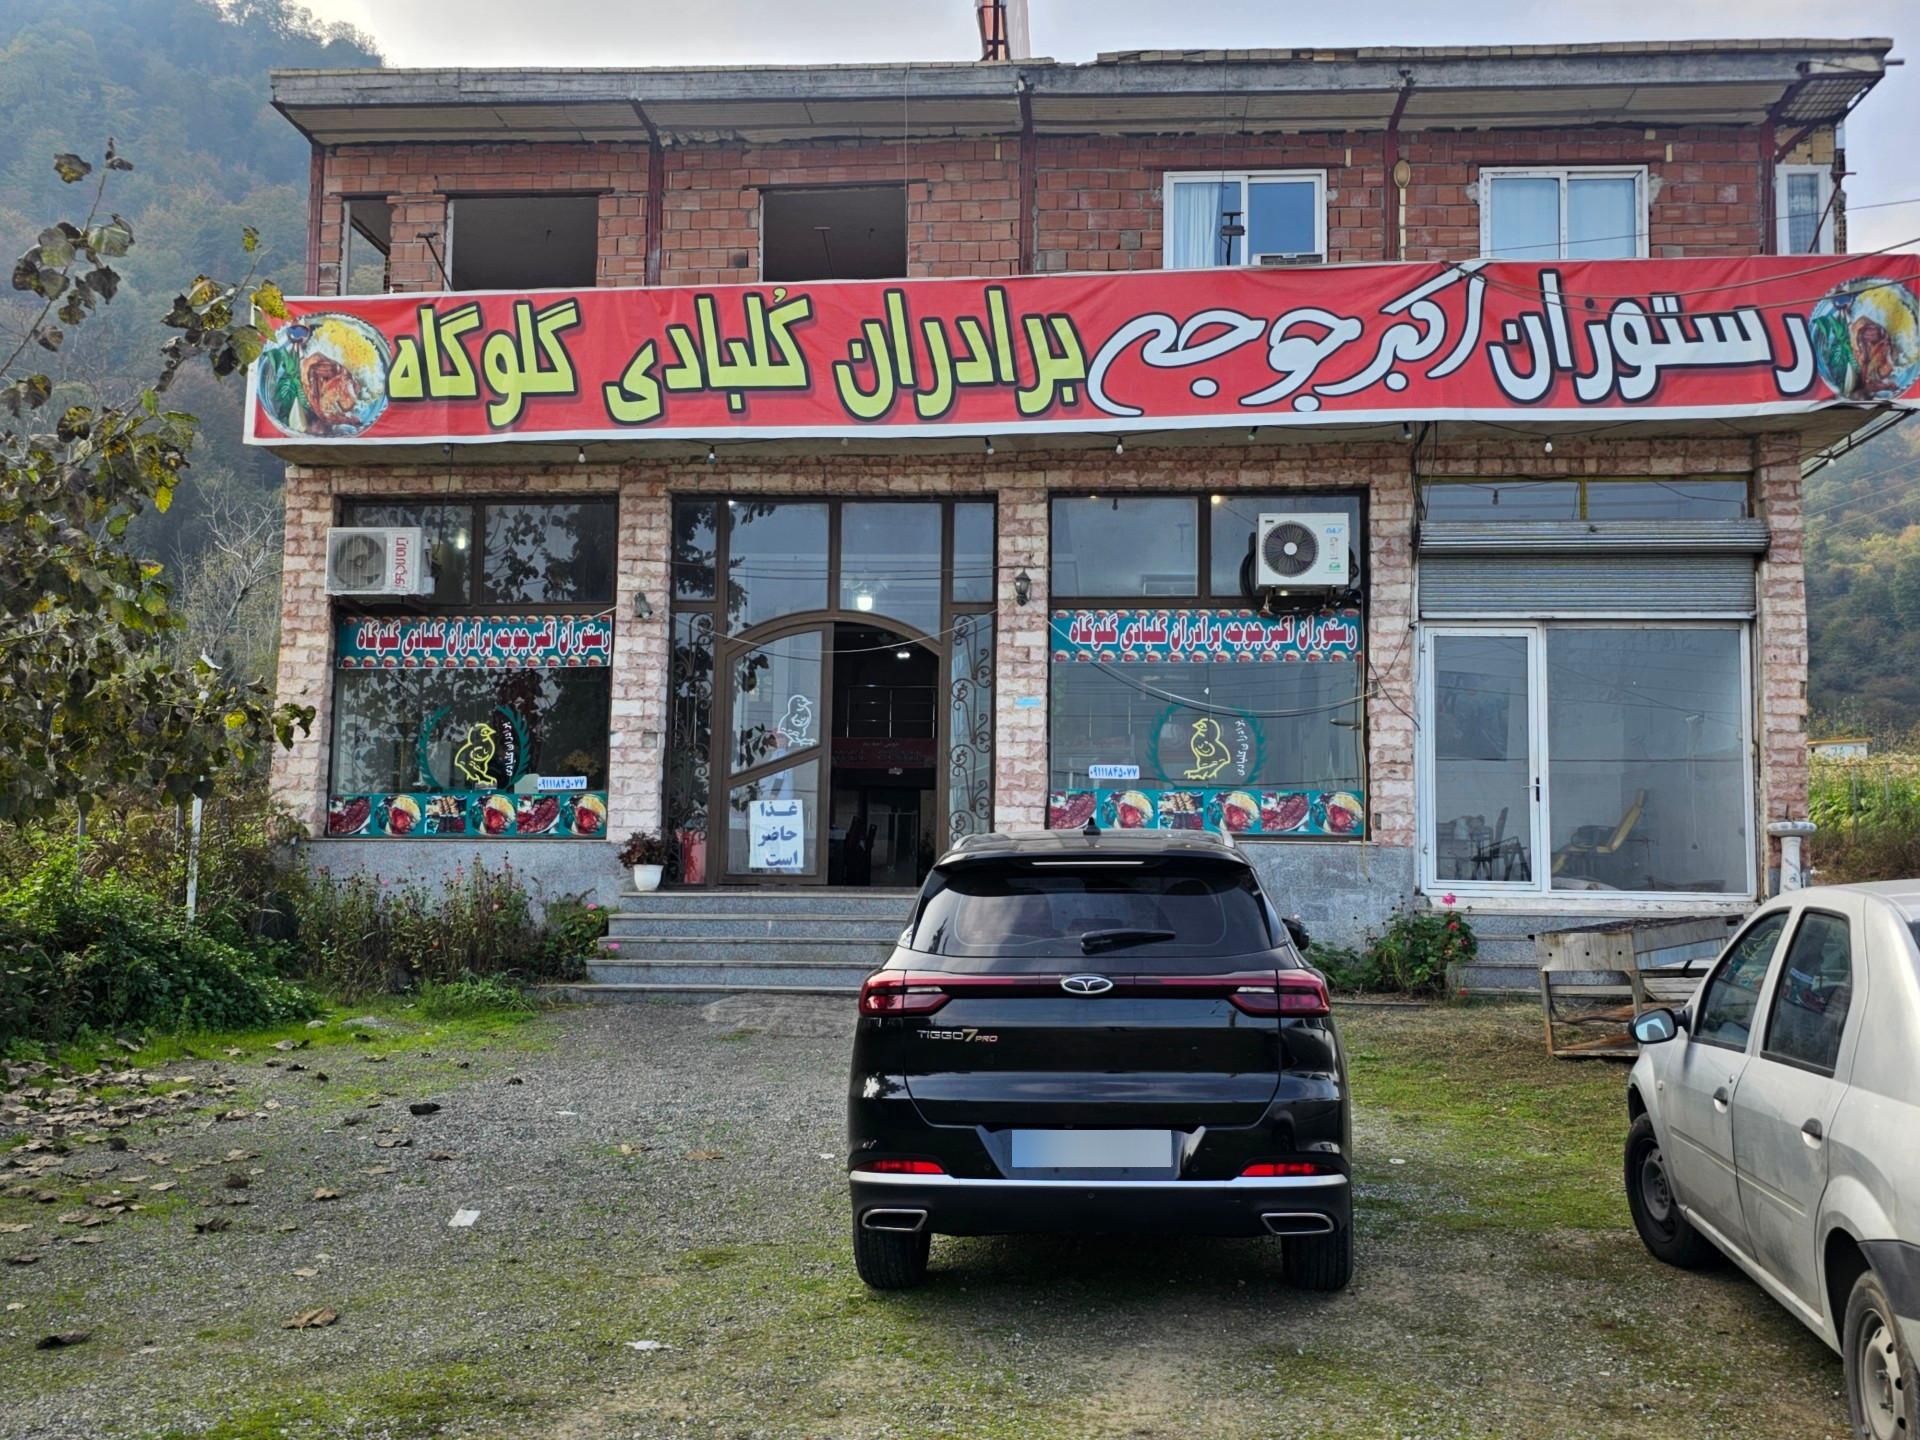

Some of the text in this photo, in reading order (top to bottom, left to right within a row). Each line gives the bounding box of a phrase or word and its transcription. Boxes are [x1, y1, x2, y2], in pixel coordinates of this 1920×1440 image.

[1488, 268, 1822, 404] رستوران
[386, 297, 580, 430] گلوگاه
[834, 287, 1089, 422] برادران
[1086, 305, 1364, 417] جوجه
[446, 622, 493, 657] برادران
[558, 621, 611, 656] رستوران
[1069, 613, 1119, 652] گلوگاه
[1170, 616, 1222, 651] برادران
[1297, 615, 1358, 651] رستوران
[760, 800, 798, 817] غذا
[757, 825, 798, 847] حاضر
[765, 848, 798, 866] است
